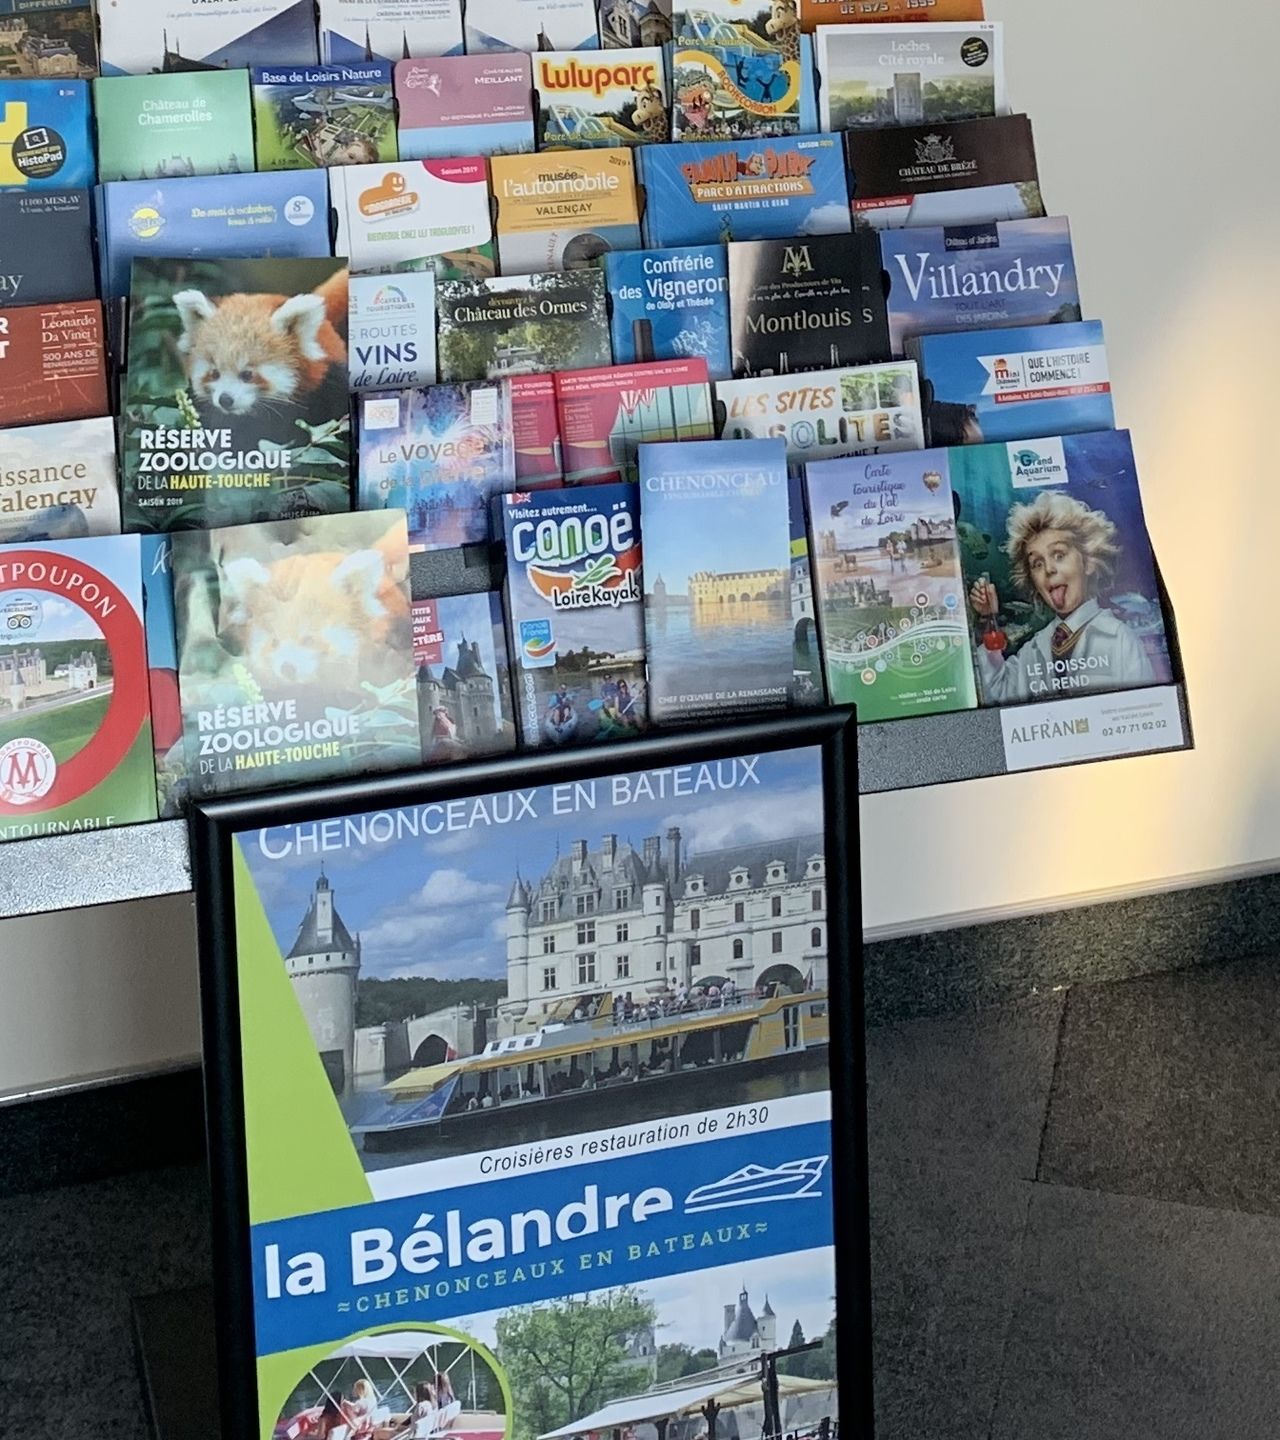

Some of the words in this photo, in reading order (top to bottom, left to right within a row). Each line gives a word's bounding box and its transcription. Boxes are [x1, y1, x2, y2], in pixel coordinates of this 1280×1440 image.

[891, 41, 930, 53] Loches
[879, 53, 903, 66] Cité
[906, 53, 944, 66] royale
[262, 72, 286, 82] Base
[288, 72, 303, 82] de
[306, 70, 340, 82] Loisirs
[342, 68, 381, 80] Nature
[475, 75, 522, 84] MEILLANT
[542, 58, 655, 95] Luluparc
[142, 99, 189, 110] Château
[192, 98, 206, 108] de
[138, 111, 212, 126] Chamerolles
[18, 150, 63, 167] HistoPad
[899, 164, 936, 176] CHÂTEAU
[949, 159, 978, 172] BRÉZÉ
[504, 172, 618, 197] l'automobile
[726, 182, 803, 196] D'ATTRACTIONS
[536, 202, 593, 216] VALENÇAY
[644, 254, 714, 275] Confrérie
[894, 252, 1065, 301] Villandry
[619, 286, 642, 300] des
[646, 276, 729, 300] Vigneron
[454, 307, 510, 324] Château
[513, 304, 537, 319] des
[540, 299, 588, 317] Ormes
[746, 307, 852, 334] Montlouis
[42, 332, 59, 342] Da
[360, 324, 418, 339] ROUTES
[356, 342, 418, 366] VINS
[1028, 357, 1044, 369] QUE
[1046, 352, 1090, 367] L'HISTOIRE
[1030, 368, 1076, 383] COMMENCE
[775, 387, 836, 411] SITES
[141, 424, 232, 450] RÉSERVE
[139, 450, 292, 472] ZOOLOGIQUE
[1016, 463, 1061, 477] Aquarium
[1021, 453, 1053, 467] Grand
[138, 476, 151, 490] DE
[154, 475, 168, 489] LA
[170, 473, 271, 489] HAUTE-TOUCHE
[646, 470, 782, 493] CHENONCEAU
[864, 464, 892, 480] Carte
[138, 498, 164, 507] SAISON
[166, 497, 184, 506] 2019
[509, 507, 540, 518] Visitez
[553, 571, 640, 610] LoireKayak
[1026, 662, 1043, 677] LE
[1046, 655, 1109, 674] POISSON
[738, 686, 786, 697] RENAISSANCE
[1030, 678, 1048, 694] ÇA
[1052, 674, 1090, 690] REND
[198, 699, 297, 732] RÉSERVE
[199, 714, 360, 755] ZOOLOGIQUE
[1010, 720, 1075, 745] ALFRAN
[200, 760, 215, 774] DE
[218, 757, 234, 772] LA
[235, 741, 341, 770] HAUTE-TOUCHE
[552, 782, 596, 816] EN
[611, 756, 762, 806] BATEAUX
[480, 1140, 574, 1175] Croisières
[580, 1120, 690, 1156] restauration
[696, 1114, 720, 1136] de
[726, 1106, 770, 1130] 2h30
[264, 1242, 326, 1300] la
[350, 1184, 673, 1286] Bélandre
[580, 1250, 614, 1270] EN
